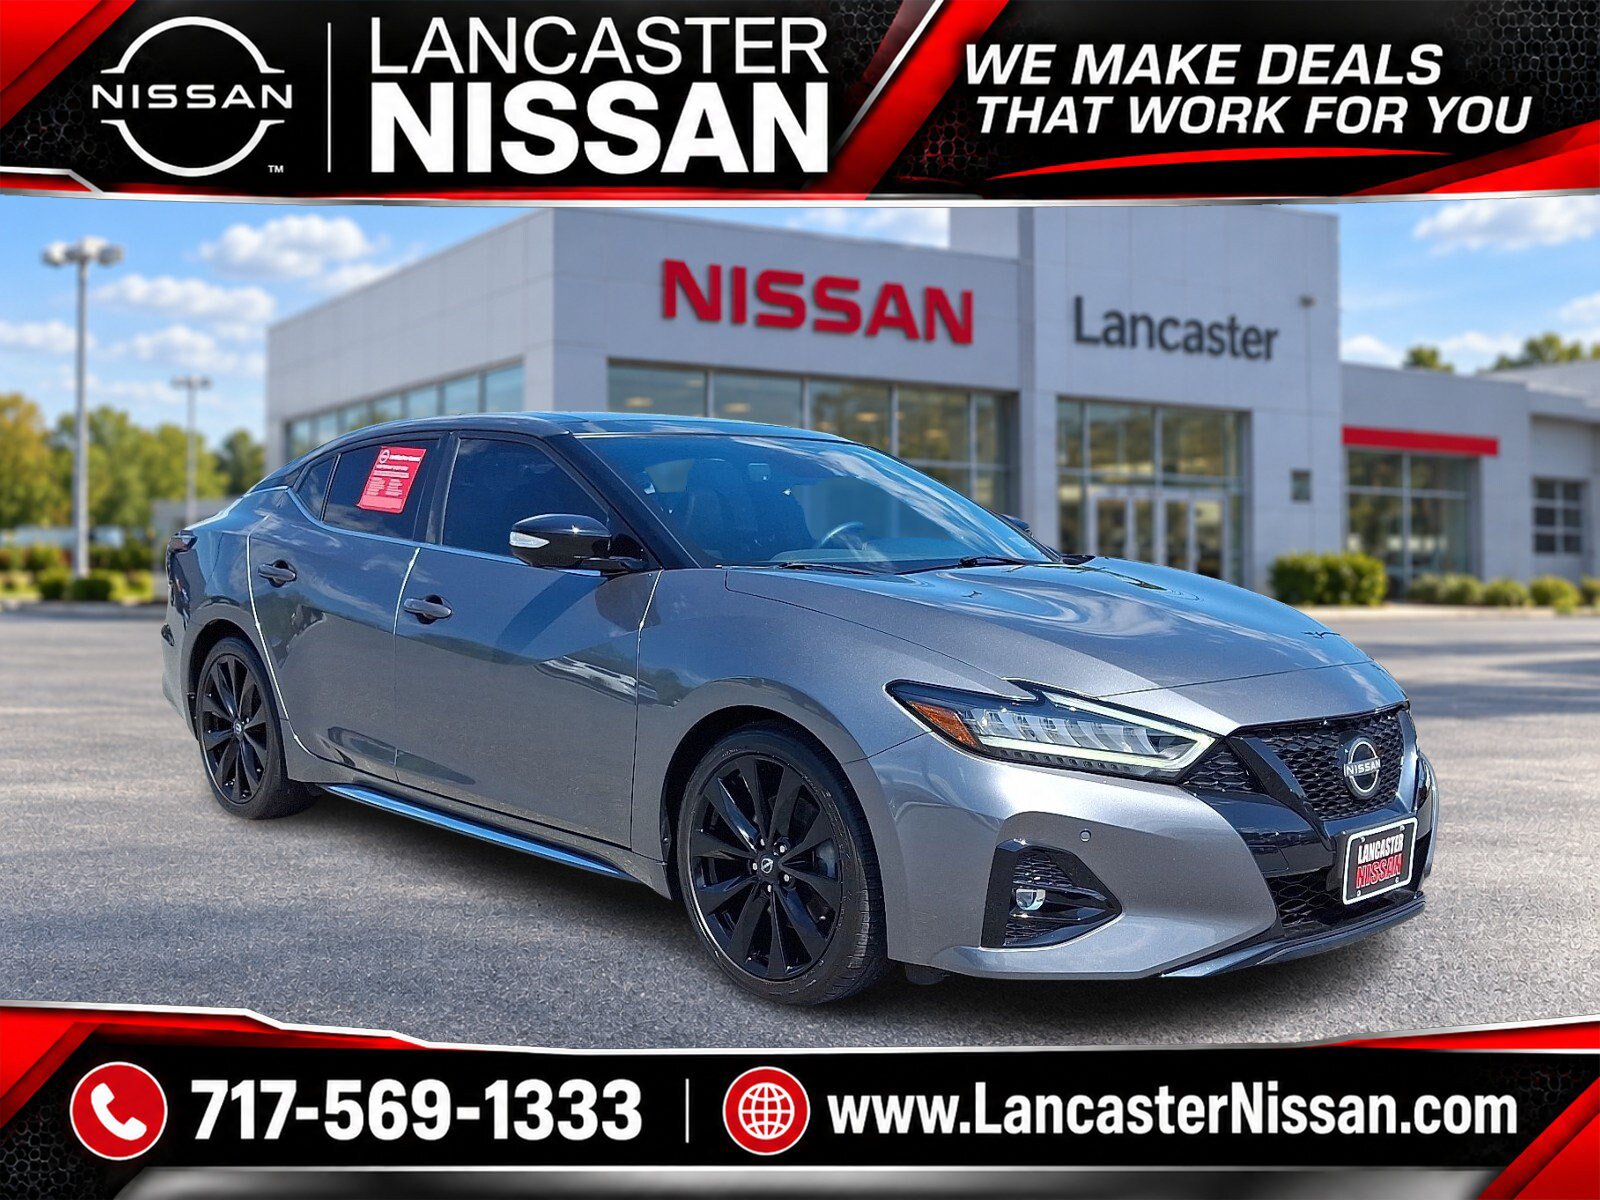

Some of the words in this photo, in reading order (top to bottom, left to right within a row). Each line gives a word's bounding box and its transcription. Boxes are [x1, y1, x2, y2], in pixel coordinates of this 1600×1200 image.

[663, 258, 974, 346] NISSAN
[1073, 295, 1279, 361] Lancaster
[1344, 757, 1381, 777] NISSAN
[1358, 833, 1404, 865] LANCASTER
[1356, 853, 1403, 889] NISSAN
